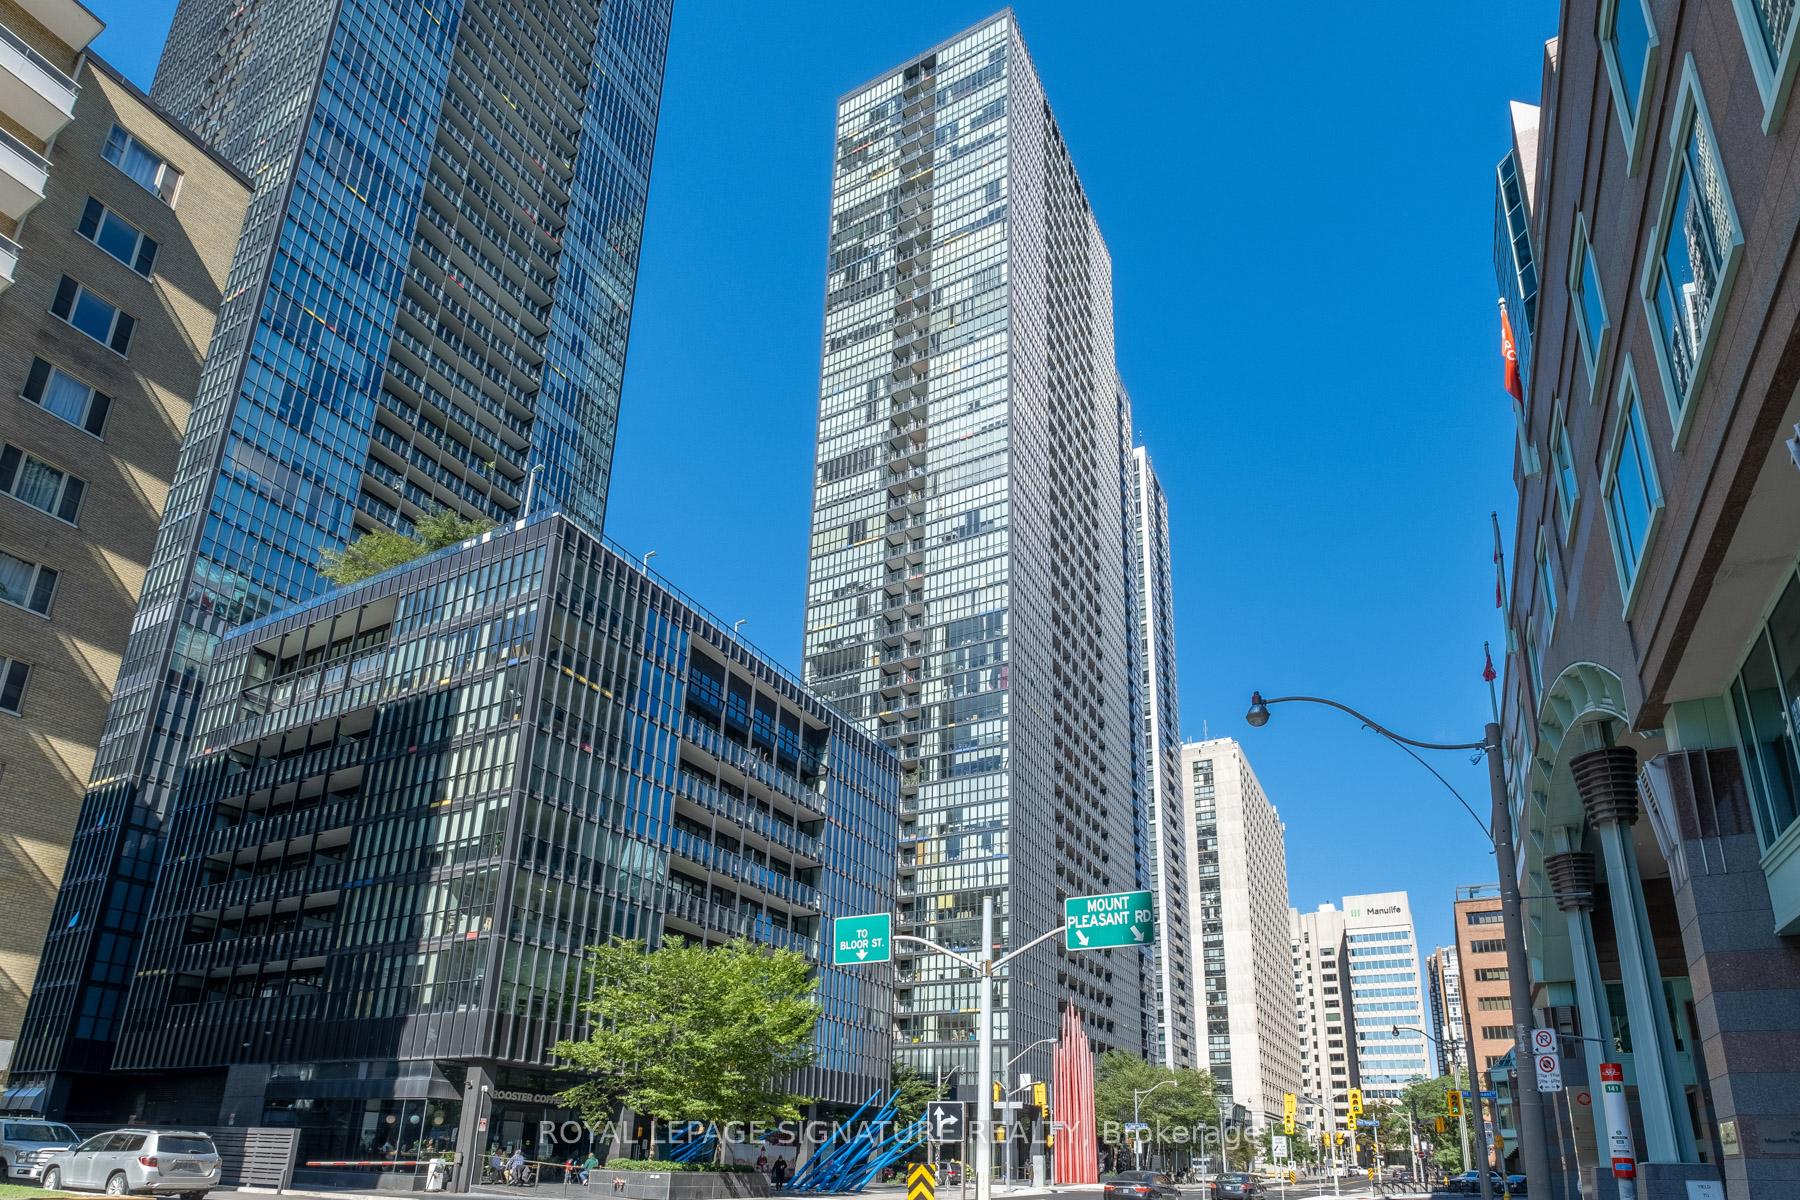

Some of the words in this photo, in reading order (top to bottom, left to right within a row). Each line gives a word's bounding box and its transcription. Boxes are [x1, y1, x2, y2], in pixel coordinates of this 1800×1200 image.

[1087, 896, 1130, 913] MOUNT
[1366, 905, 1401, 915] Manulife
[1067, 911, 1130, 929] PLEASANT
[856, 928, 868, 939] TO
[840, 939, 869, 951] BLOOR
[871, 937, 885, 948] ST.
